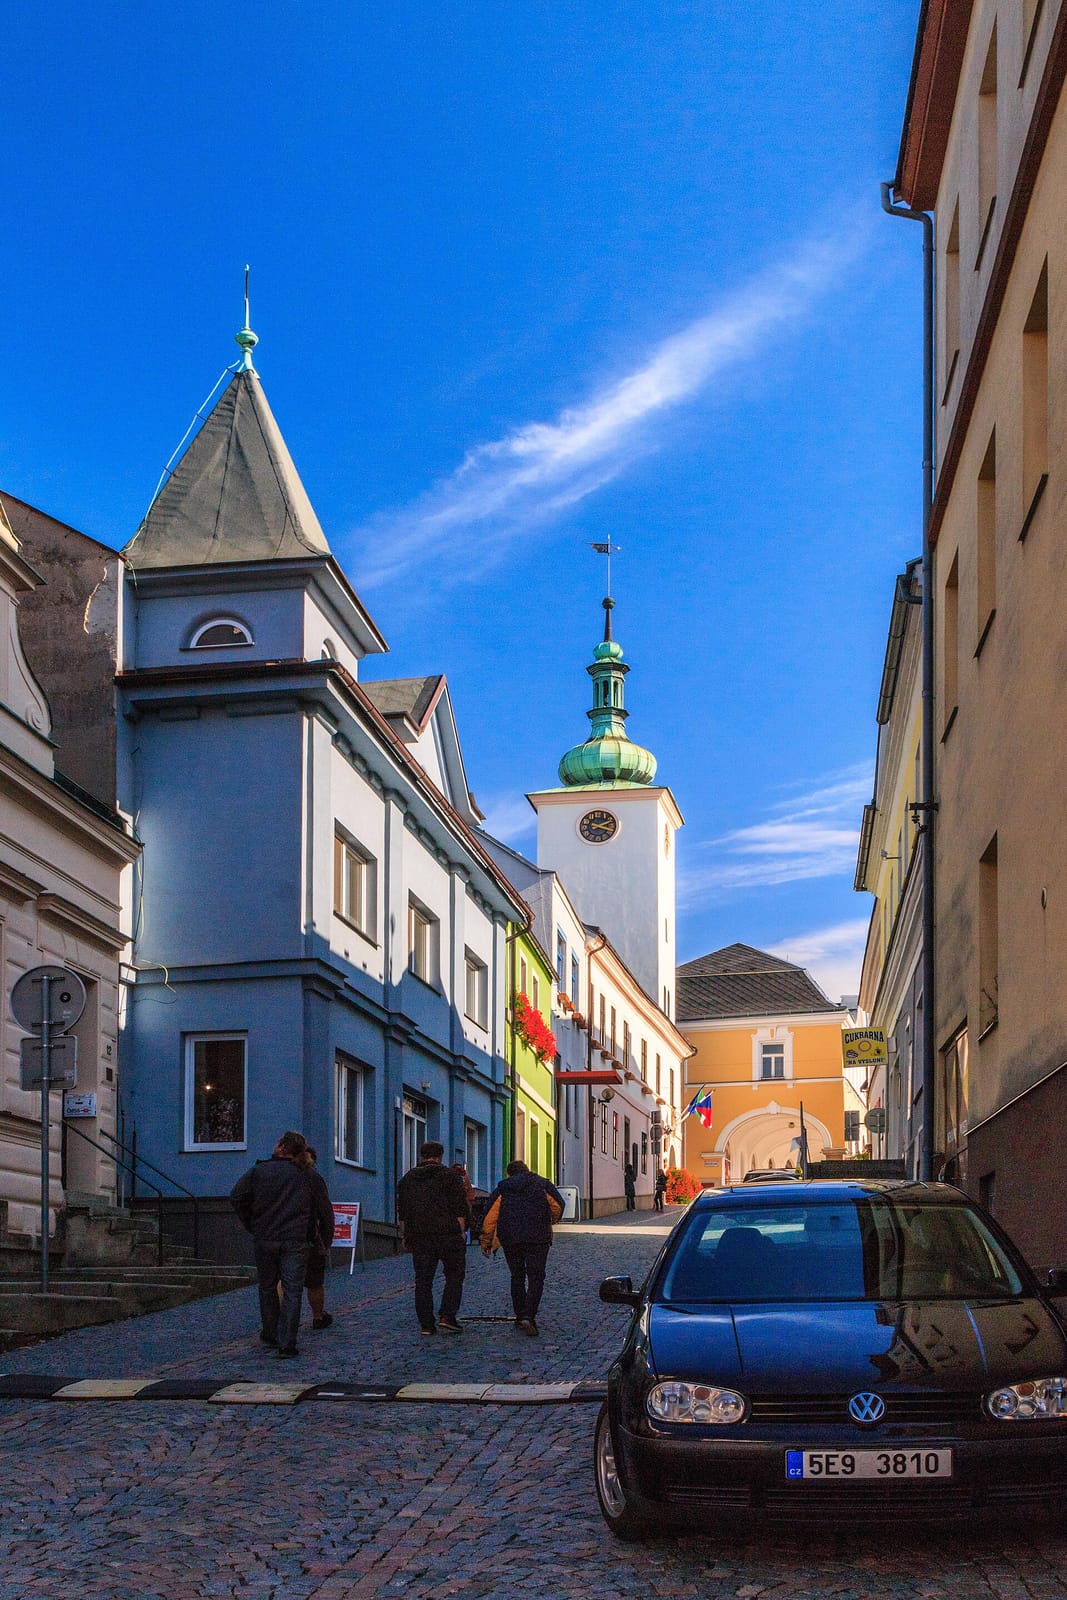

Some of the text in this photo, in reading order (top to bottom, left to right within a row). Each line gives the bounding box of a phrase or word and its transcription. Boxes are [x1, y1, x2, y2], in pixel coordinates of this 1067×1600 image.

[849, 1392, 885, 1421] VW
[809, 1454, 855, 1475] 5E9
[876, 1453, 939, 1475] 3810
